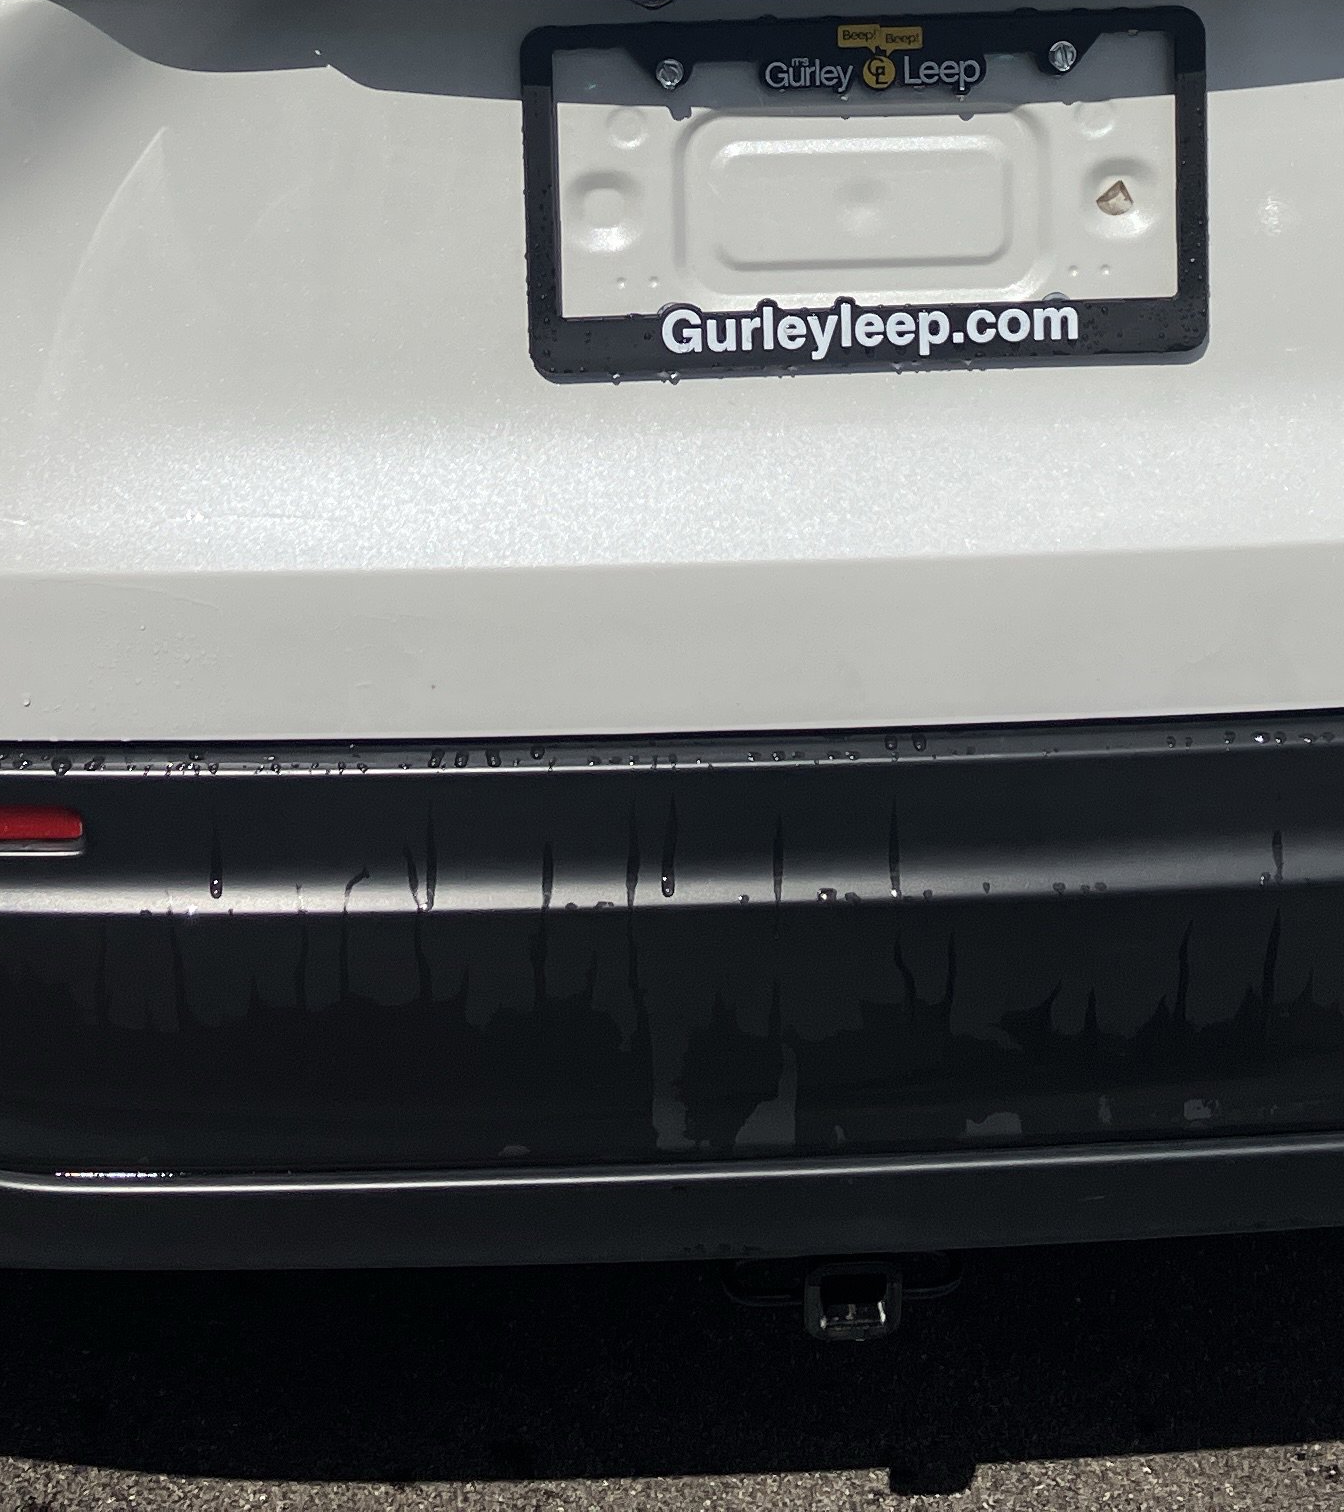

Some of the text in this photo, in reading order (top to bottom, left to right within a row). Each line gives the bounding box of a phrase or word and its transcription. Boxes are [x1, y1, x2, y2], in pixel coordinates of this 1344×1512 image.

[842, 29, 919, 45] Beep! Beep!
[765, 58, 854, 93] Gurley
[904, 55, 981, 91] Leep
[662, 302, 1080, 360] Gurleyleep.com
